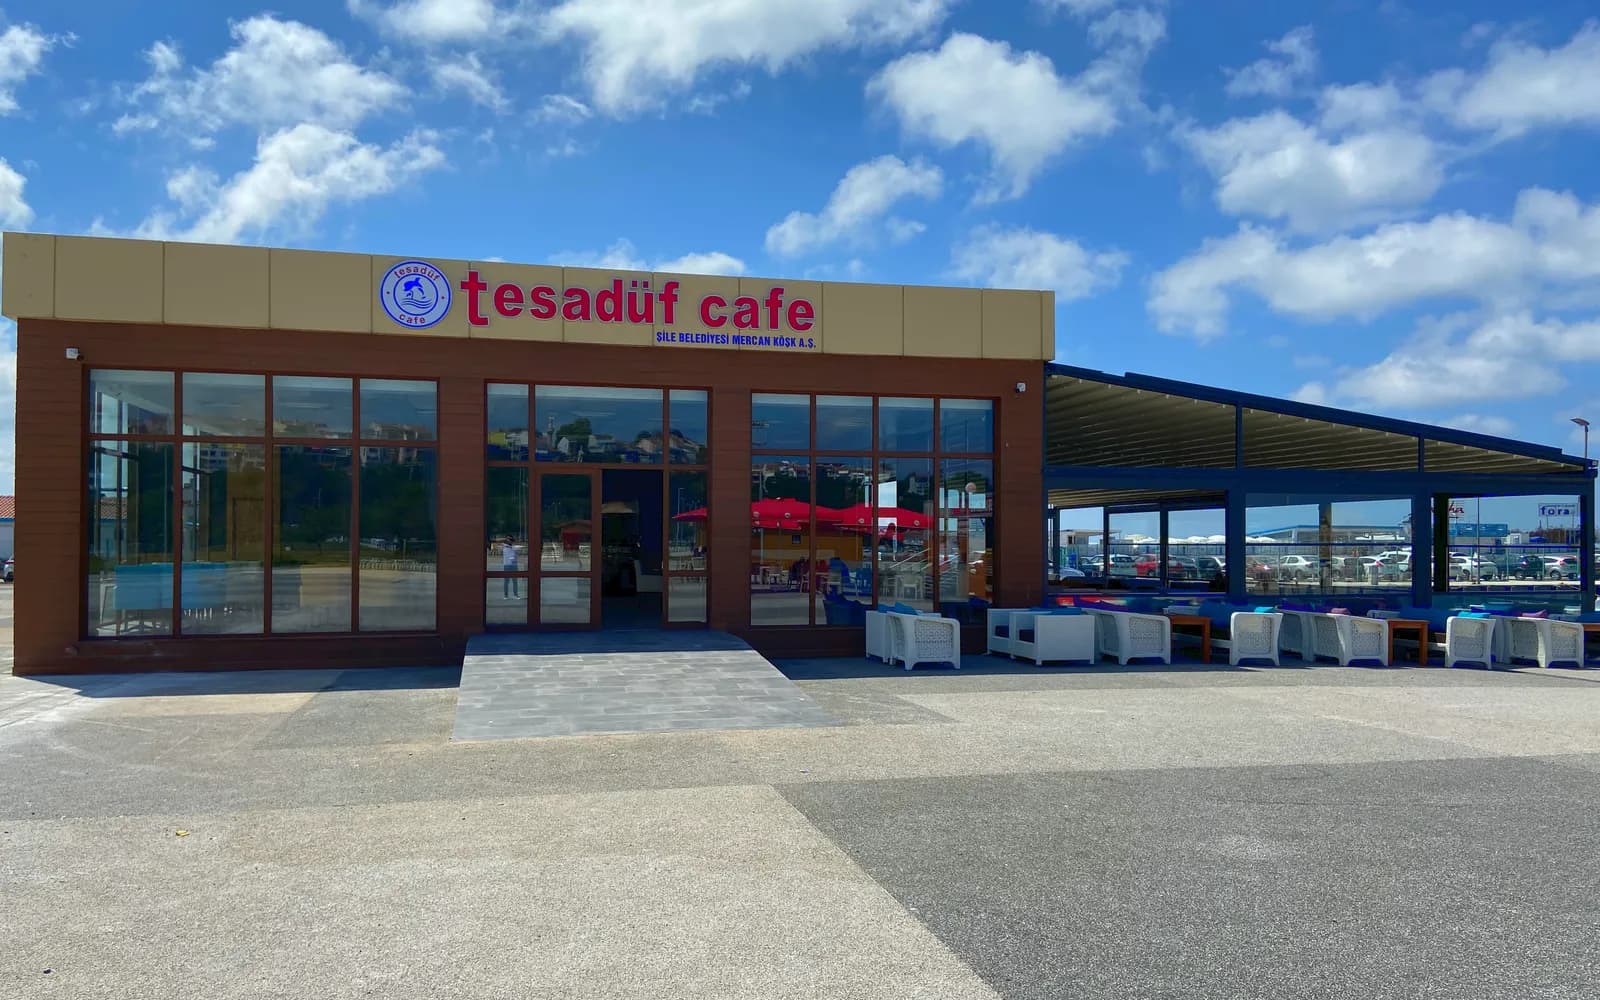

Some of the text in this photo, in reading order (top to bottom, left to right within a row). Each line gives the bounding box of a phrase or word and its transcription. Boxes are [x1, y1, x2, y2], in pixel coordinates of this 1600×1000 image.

[461, 270, 815, 332] tesadüf cafe
[399, 313, 426, 325] cafe
[732, 335, 770, 346] MERCAN
[1541, 505, 1570, 516] fora
